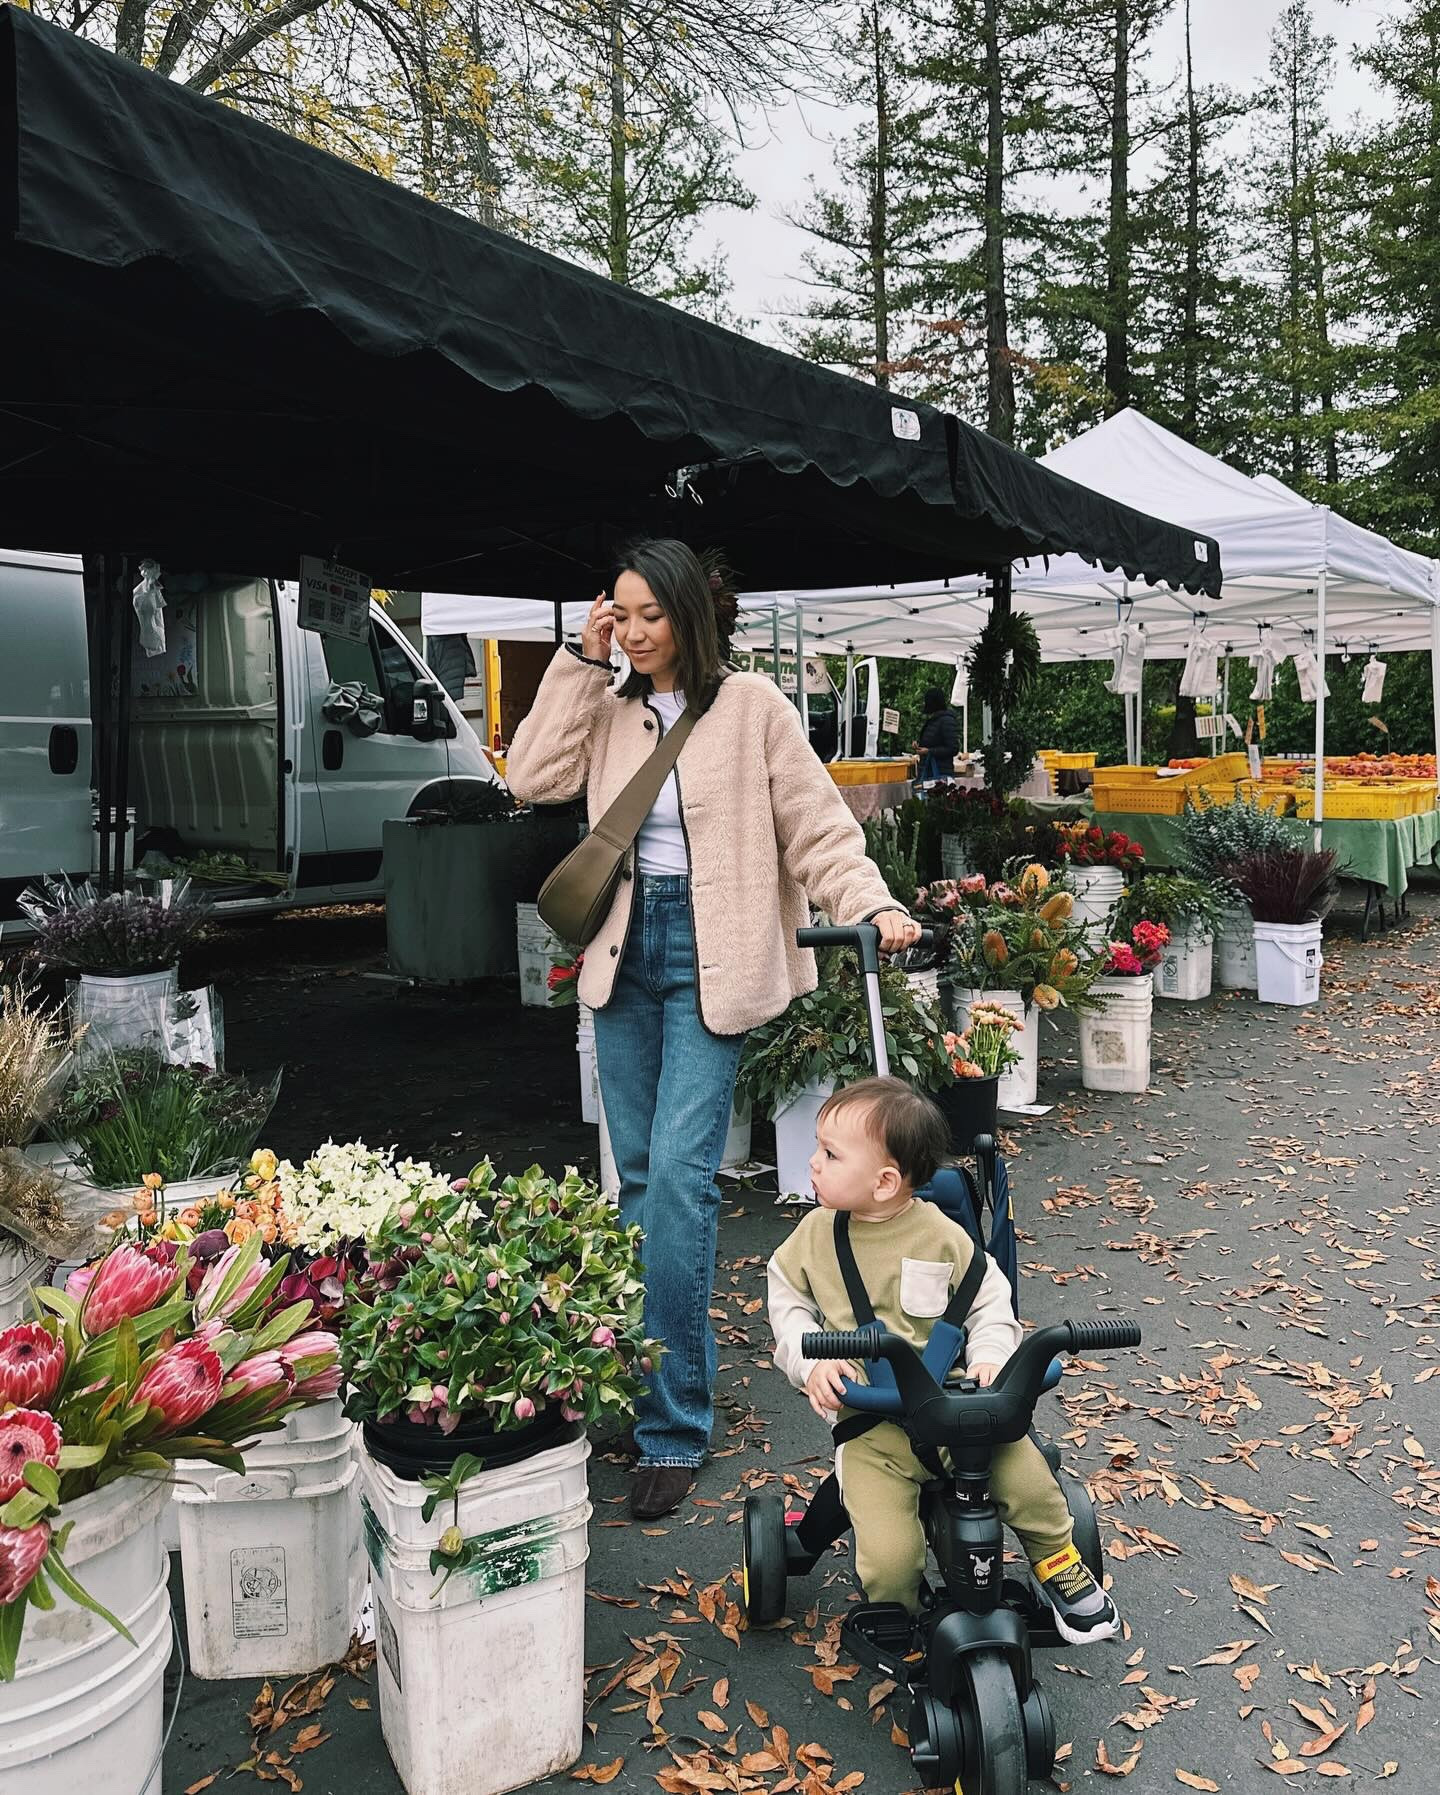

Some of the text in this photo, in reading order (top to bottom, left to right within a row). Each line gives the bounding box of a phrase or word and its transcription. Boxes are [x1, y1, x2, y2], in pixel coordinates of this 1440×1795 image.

[335, 565, 357, 580] ACCEPT
[306, 576, 328, 592] VISA
[782, 676, 794, 684] Sell
